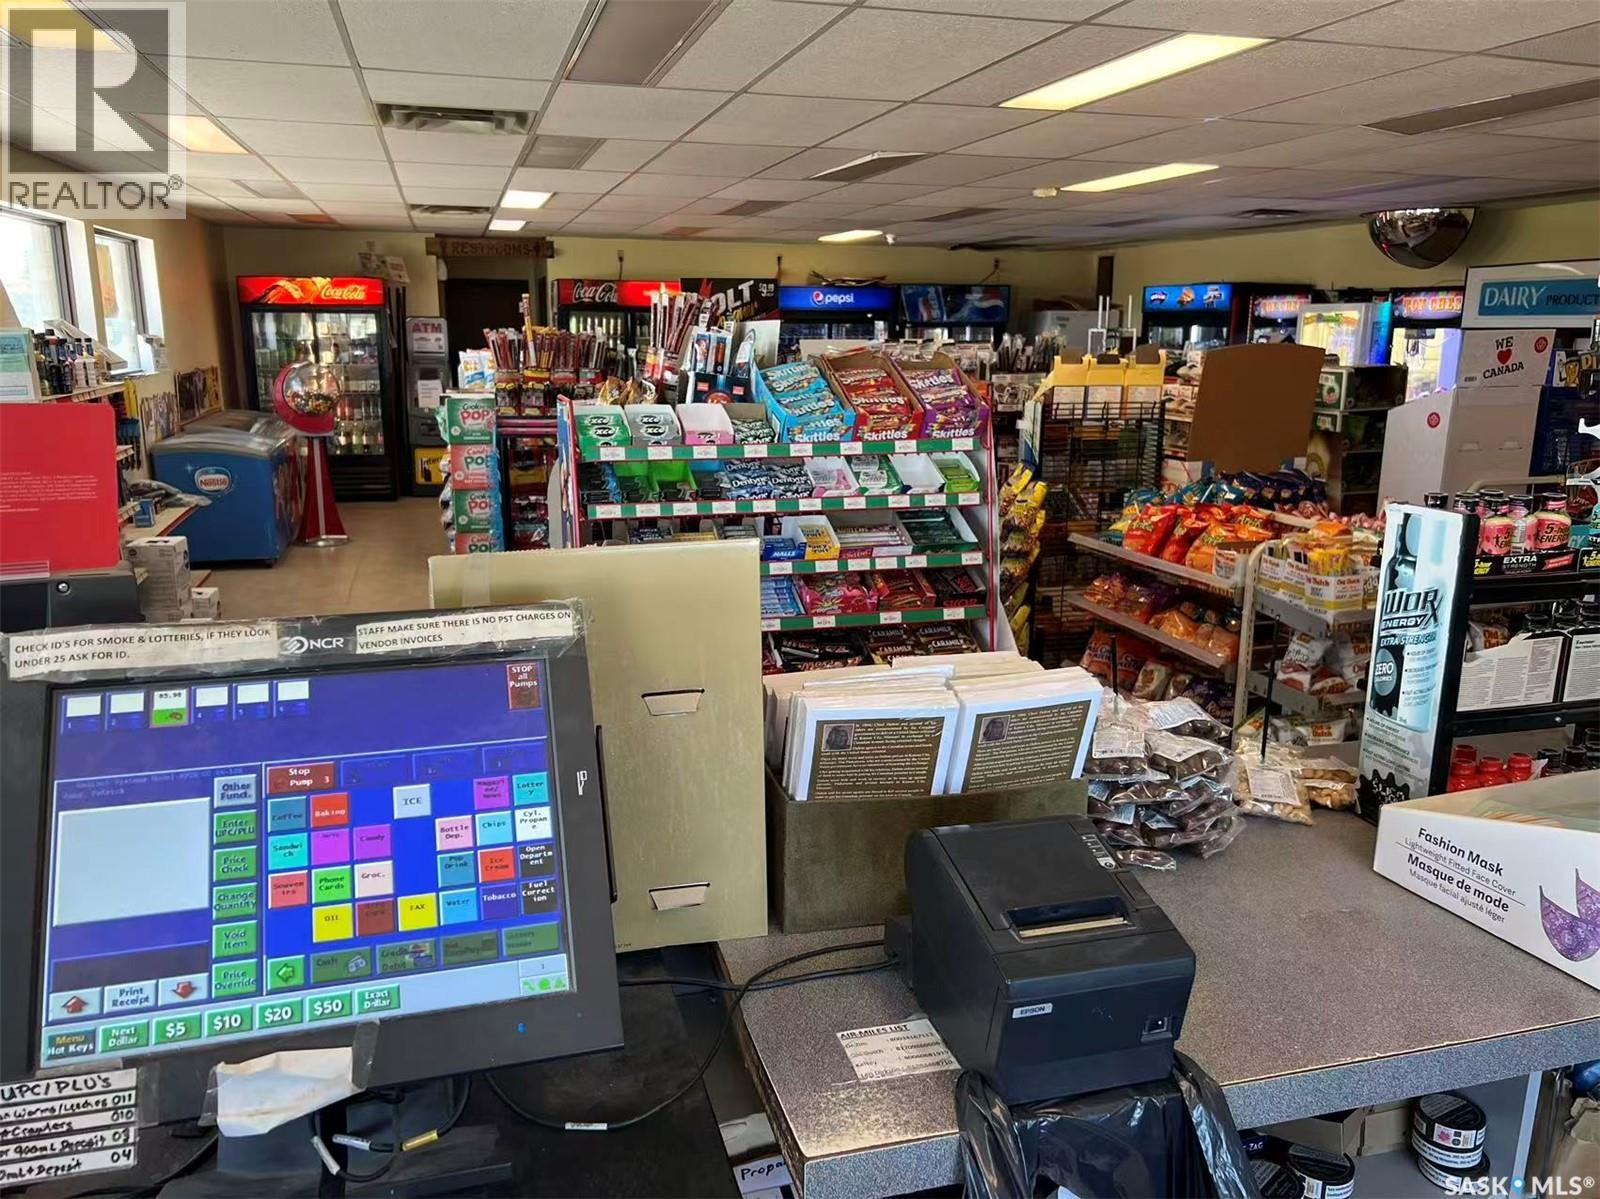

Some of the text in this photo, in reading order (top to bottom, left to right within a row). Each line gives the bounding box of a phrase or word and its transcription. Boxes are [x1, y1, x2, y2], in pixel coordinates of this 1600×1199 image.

[824, 292, 855, 305] pepsi
[1485, 286, 1547, 309] DAIRY
[411, 322, 442, 333] ATM
[1495, 336, 1514, 350] WE
[1483, 362, 1525, 379] CANADA
[460, 410, 490, 424] POP
[795, 432, 841, 442] Skittles
[863, 430, 909, 441] Skittles
[932, 427, 976, 439] Skittles
[732, 476, 768, 487] Dentyne
[771, 475, 808, 485] Dentyne
[1503, 556, 1537, 564] EXTRA
[358, 611, 571, 636] STAFF MAKE SURE THERE IS NO PST CHARGES ON
[1381, 614, 1425, 630] ENERGY
[15, 628, 271, 653] CHECK ID'S FOR SMOKE & LOTTERIES, IF THEY LOOK
[309, 637, 345, 650] NCR
[358, 633, 444, 650] VENDOR INVOICES
[931, 638, 965, 648] CARAMILK
[1380, 633, 1400, 648] EXTRA
[15, 650, 130, 668] UNDER 25 ASK FOR ID.
[511, 665, 534, 674] STOP
[1375, 662, 1394, 676] ZERO
[509, 679, 538, 688] Pumps
[288, 768, 311, 777] Stop
[222, 783, 250, 791] Other
[290, 778, 313, 787] Pump
[403, 797, 423, 806] ICE
[223, 820, 249, 828] Enter
[440, 825, 469, 833] Bottle
[482, 820, 506, 829] Chips
[215, 827, 255, 838] UPC/PLU
[525, 845, 545, 853] Open
[1418, 827, 1504, 877] Fashion Mask
[223, 856, 246, 865] Price
[222, 863, 248, 873] Check
[1404, 837, 1516, 897] Lightweight Fitted Face Cover
[319, 876, 345, 884] Phone
[1407, 853, 1509, 912] Masque de mode
[319, 883, 345, 891] Cards
[1409, 869, 1438, 889] Masque
[1438, 882, 1459, 900] facial
[1460, 893, 1484, 913] ajusté
[218, 890, 254, 901] Change
[483, 892, 516, 902] Tobacco
[214, 900, 257, 912] Quantity
[224, 930, 246, 939] Void
[224, 940, 248, 948] Item
[223, 970, 246, 979] Price
[215, 979, 256, 990] Override
[119, 987, 144, 997] Print
[112, 996, 149, 1007] Receipt
[364, 999, 391, 1009] Dollar
[313, 999, 343, 1016] $50
[1019, 1005, 1046, 1016] EPSON
[264, 1006, 292, 1023] $20
[213, 1014, 242, 1031] $10
[111, 1027, 135, 1036] Next
[165, 1022, 186, 1038] $5
[888, 1024, 911, 1034] LIST
[55, 1034, 85, 1044] Menu
[108, 1036, 138, 1047] Dollar
[68, 1043, 93, 1053] Keys
[111, 1110, 134, 1122] 010
[111, 1149, 132, 1163] 04
[741, 1160, 787, 1181] Propa
